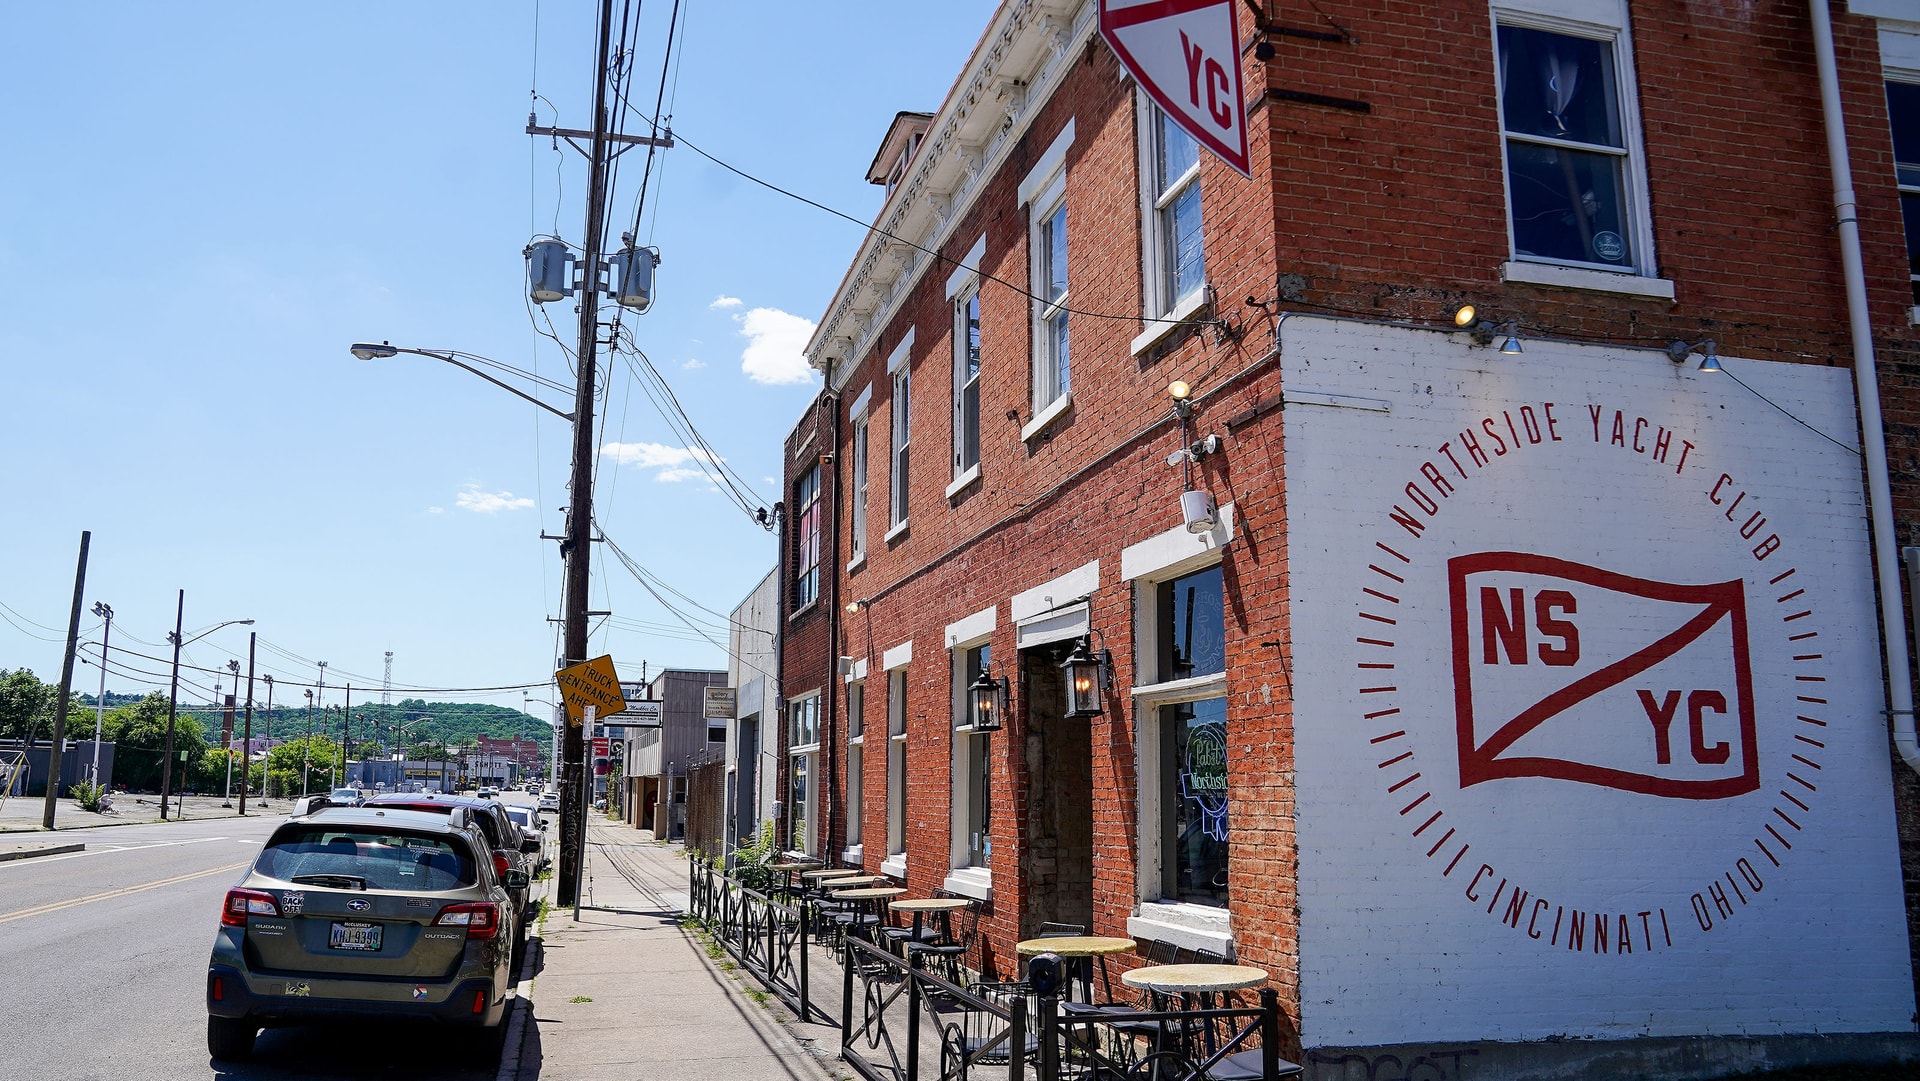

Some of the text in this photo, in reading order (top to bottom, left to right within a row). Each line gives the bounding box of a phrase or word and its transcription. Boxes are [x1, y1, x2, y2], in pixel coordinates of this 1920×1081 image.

[1178, 28, 1232, 131] YC
[1389, 402, 1781, 561] NORTHSIDE YACHT CLUB
[1480, 587, 1580, 667] NS
[565, 673, 617, 708] ENTRANCE
[567, 692, 602, 716] AHED
[583, 665, 614, 690] TRUCK
[1636, 689, 1731, 765] YC
[1190, 772, 1228, 789] Northsid
[282, 897, 304, 905] BACK
[1465, 857, 1764, 955] CINCINNATI OHIO
